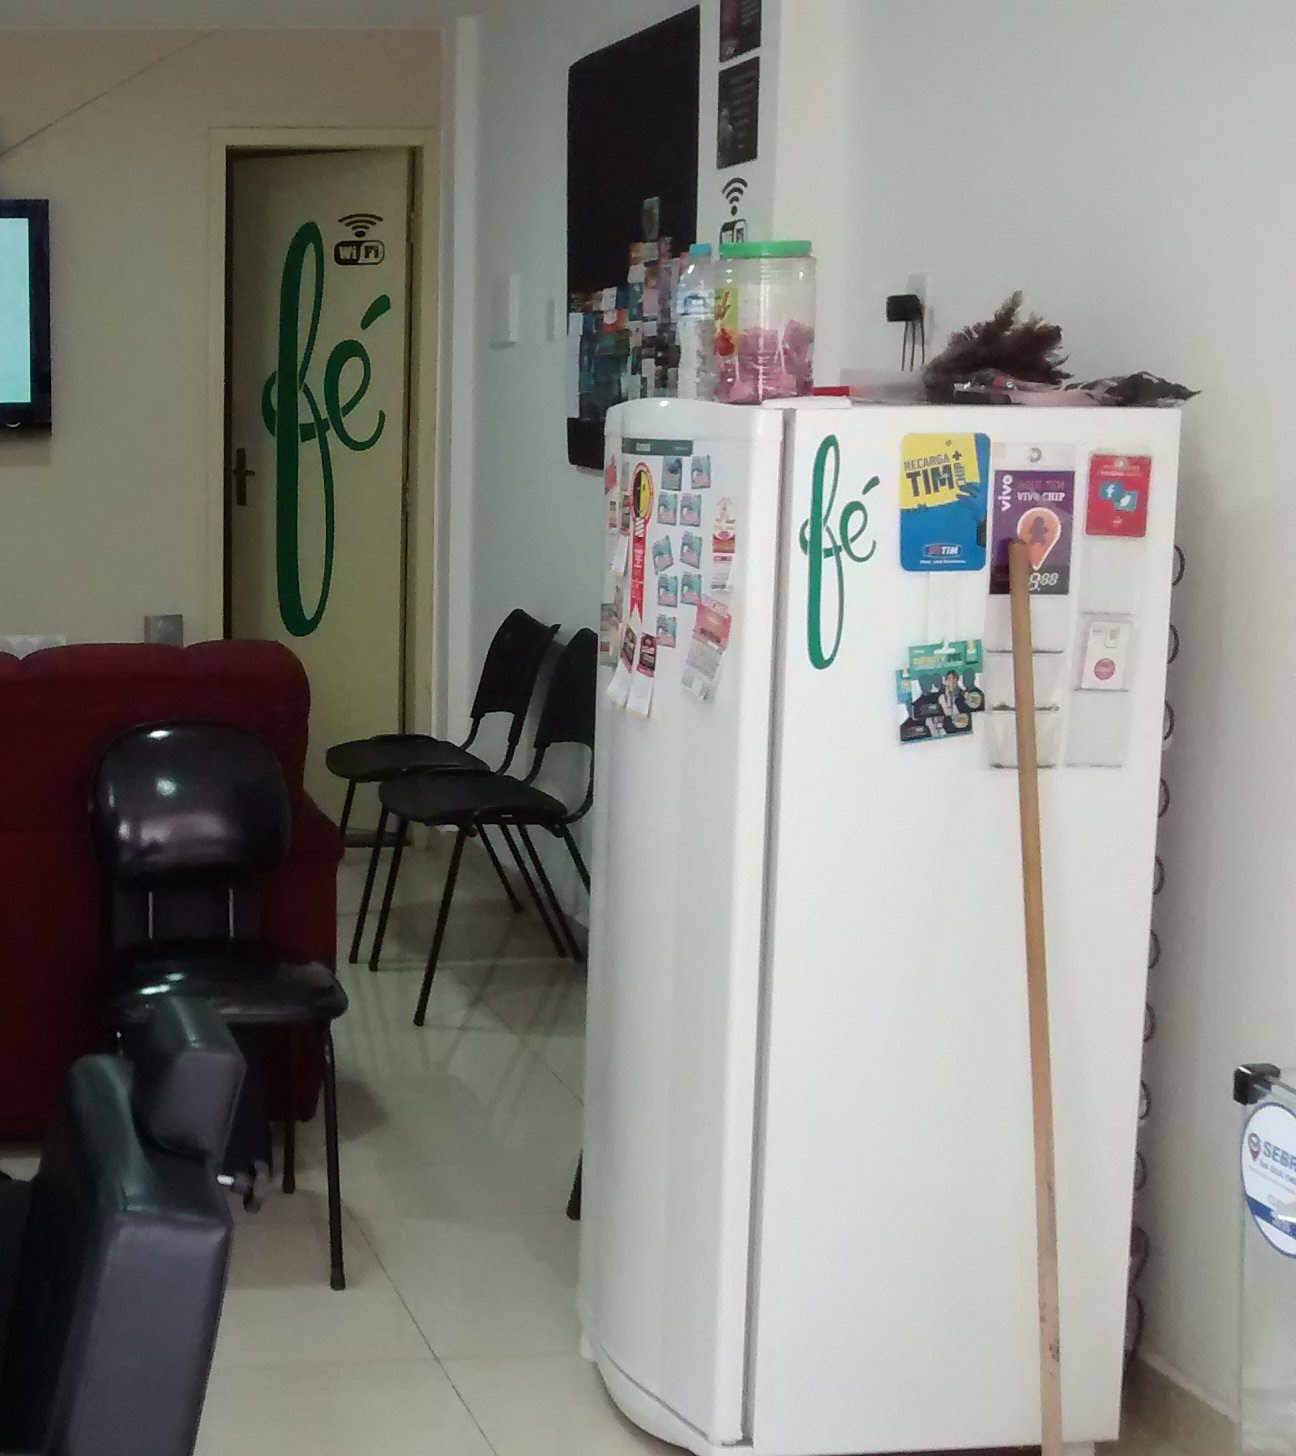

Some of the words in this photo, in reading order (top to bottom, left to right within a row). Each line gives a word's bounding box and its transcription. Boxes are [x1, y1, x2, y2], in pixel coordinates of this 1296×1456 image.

[262, 221, 392, 637] fé
[904, 453, 951, 472] RECARGA
[906, 464, 955, 497] TIM
[998, 474, 1013, 511] vivo
[1017, 491, 1040, 501] VIVO
[1042, 492, 1066, 502] CHIP
[799, 434, 880, 670] fé
[941, 546, 959, 555] TIM
